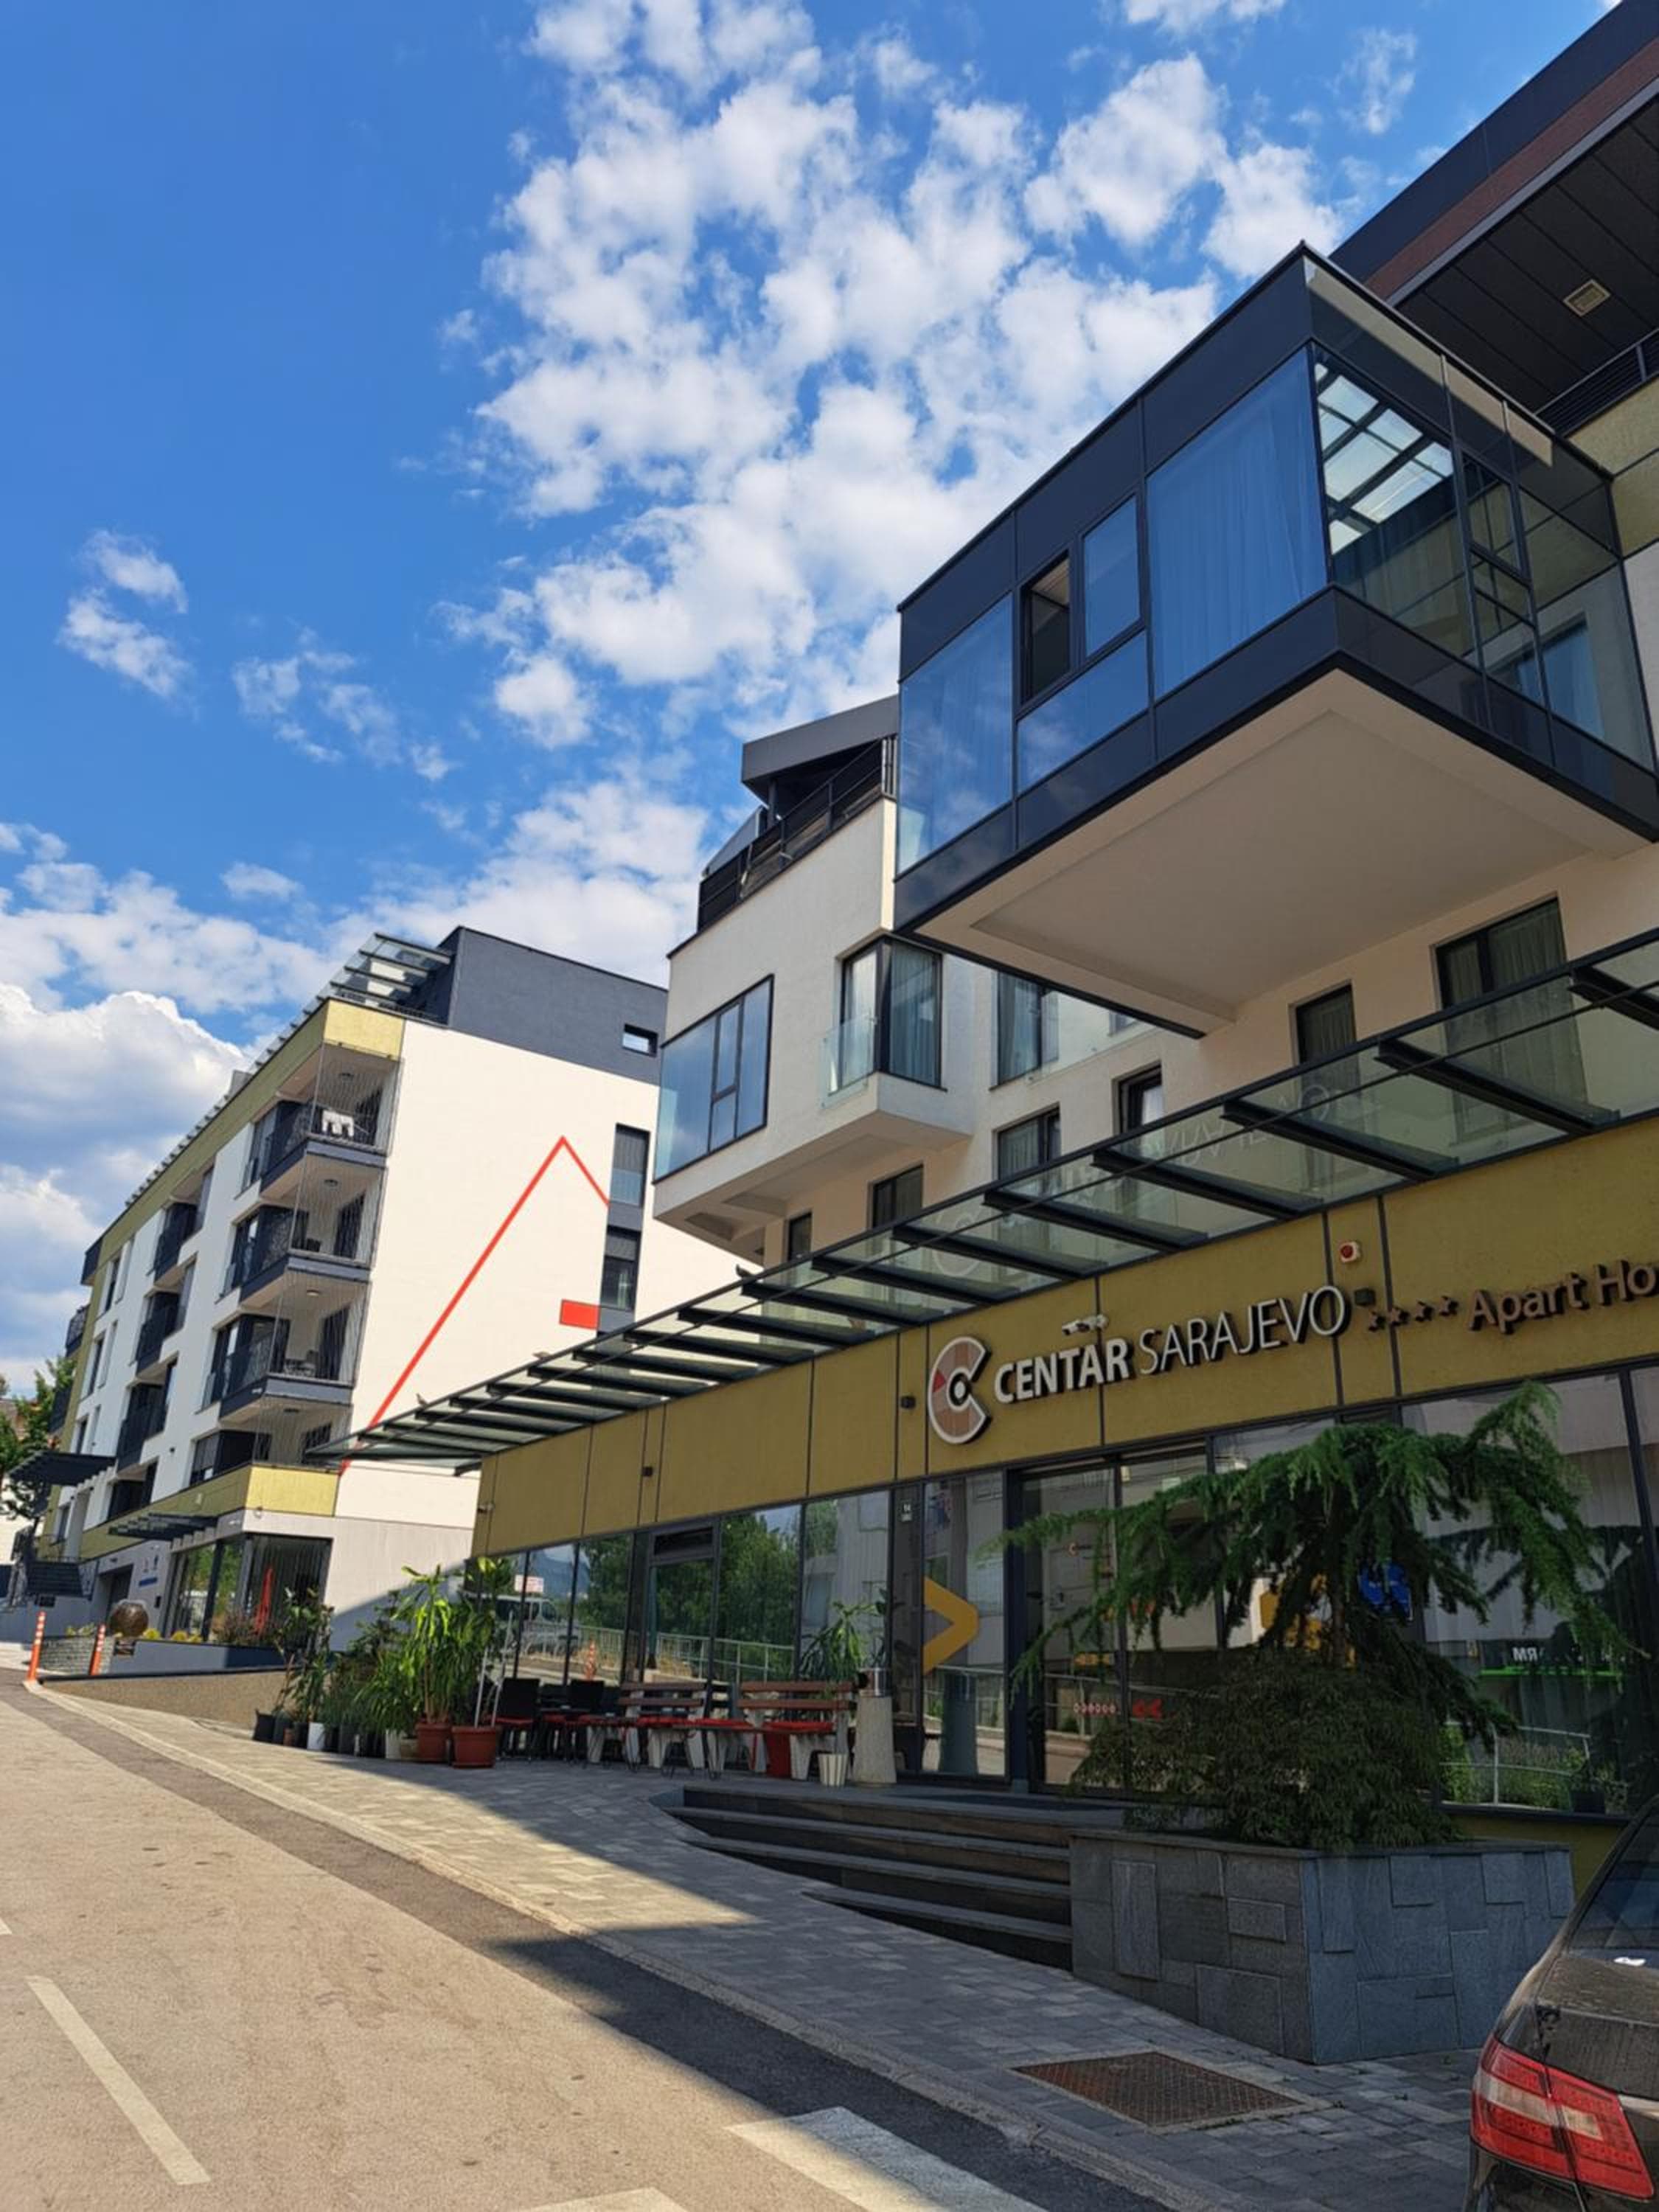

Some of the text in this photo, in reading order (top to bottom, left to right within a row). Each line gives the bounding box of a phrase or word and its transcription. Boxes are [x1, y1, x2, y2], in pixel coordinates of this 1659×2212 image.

[994, 1338, 1130, 1404] CENTAR
[1138, 1285, 1346, 1375] SARAJEVO
[1467, 1274, 1585, 1335] Apart
